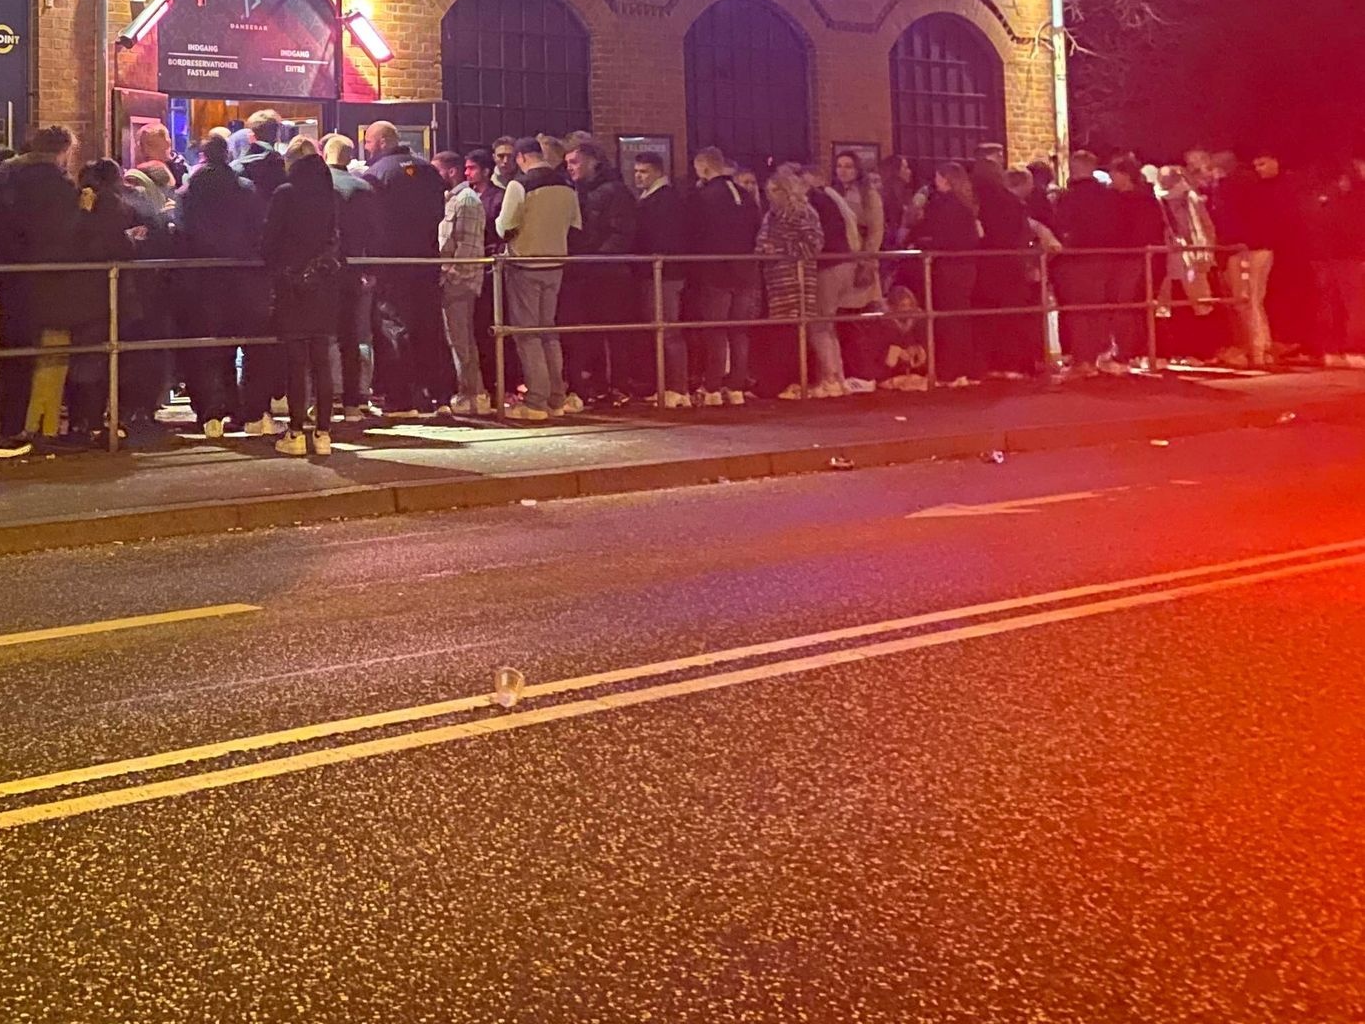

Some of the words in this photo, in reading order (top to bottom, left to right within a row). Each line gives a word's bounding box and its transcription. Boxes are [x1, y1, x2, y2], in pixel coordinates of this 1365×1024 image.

[229, 23, 268, 31] DANSEBAR
[188, 43, 218, 52] INDGANG
[280, 49, 310, 58] INDGANG
[187, 69, 219, 77] FASTLANE
